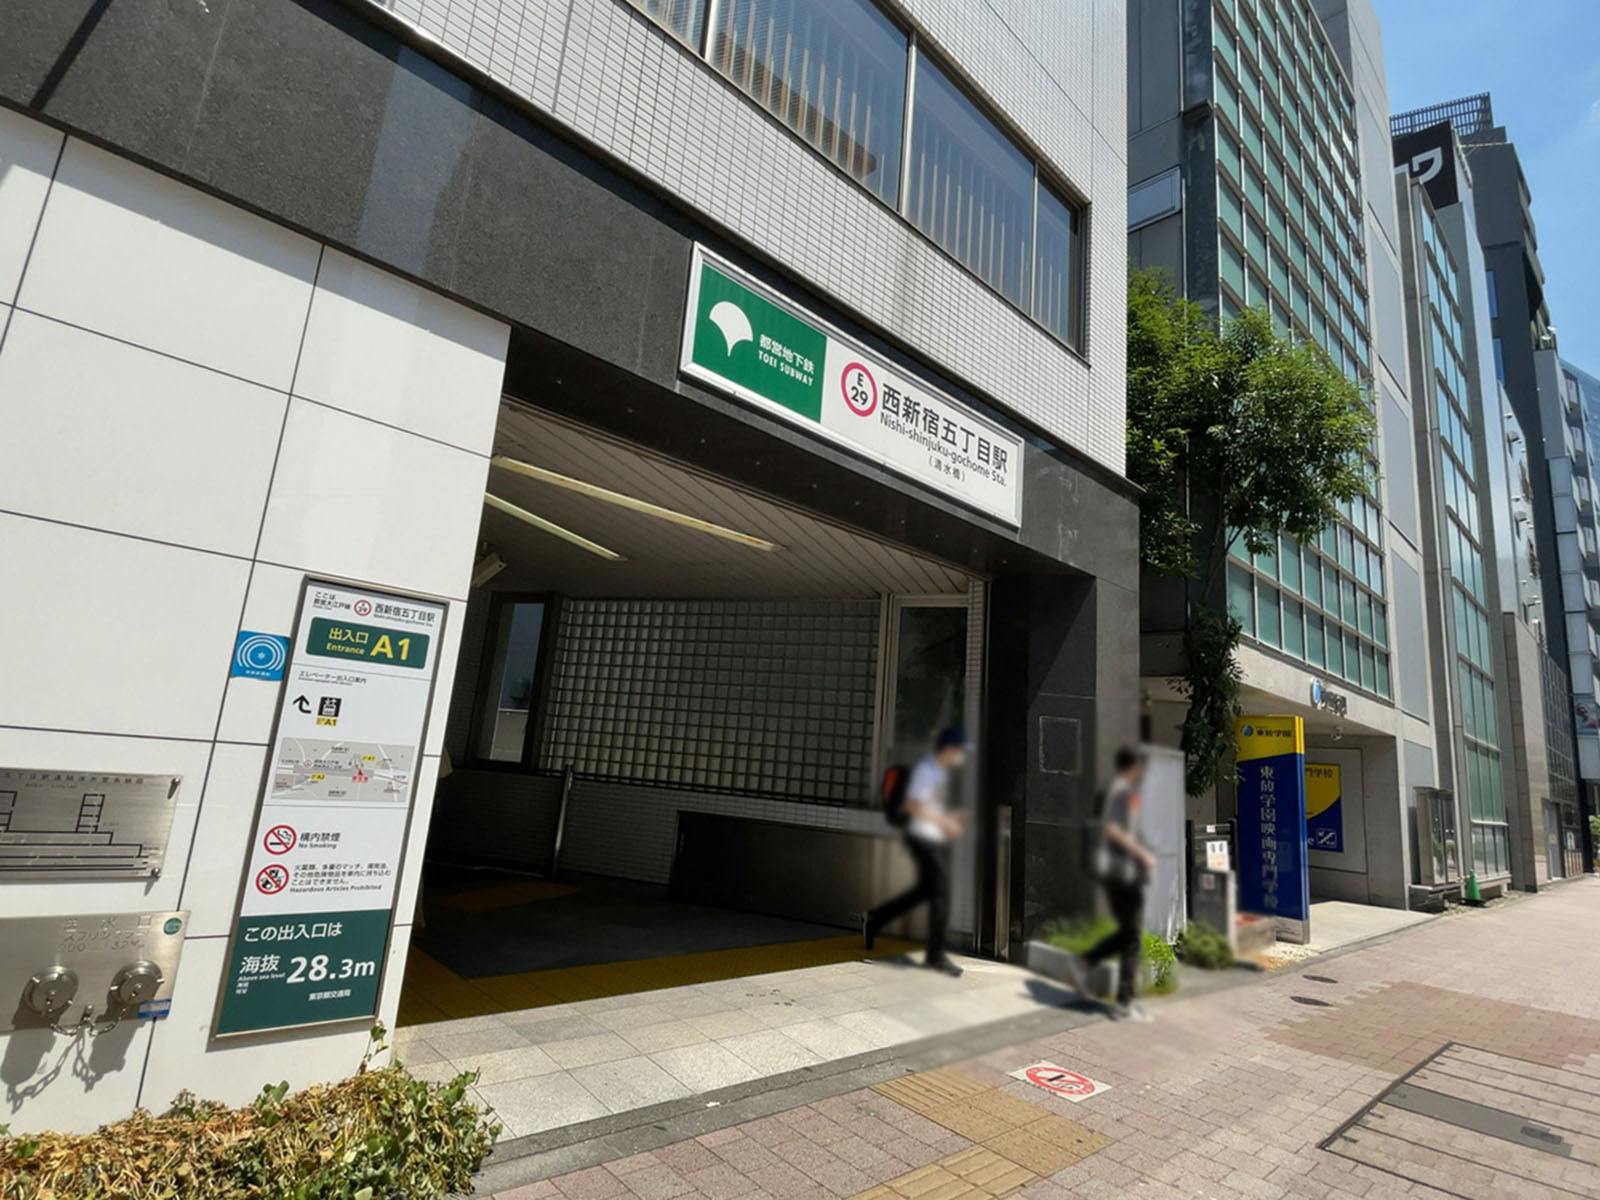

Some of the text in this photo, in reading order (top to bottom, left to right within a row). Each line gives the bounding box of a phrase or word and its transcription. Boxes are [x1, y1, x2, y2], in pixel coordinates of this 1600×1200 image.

[760, 334, 814, 375] 都営地下鉄
[758, 350, 813, 386] TOEI SUBWAY
[857, 372, 864, 387] E
[851, 386, 868, 405] 29
[882, 383, 1008, 473] 西新宿五丁目駅
[880, 412, 1007, 487] Nishi-shinjuku-gochome Sta.
[315, 591, 336, 600] ここは
[375, 603, 436, 622] 西新宿五丁目駅
[328, 628, 369, 644] 出入口
[326, 642, 365, 655] Entrance
[370, 634, 410, 661] A1
[300, 832, 341, 842] 構内禁煙
[244, 922, 343, 942] この出入口は
[240, 953, 376, 984] 海抜 28.3m
